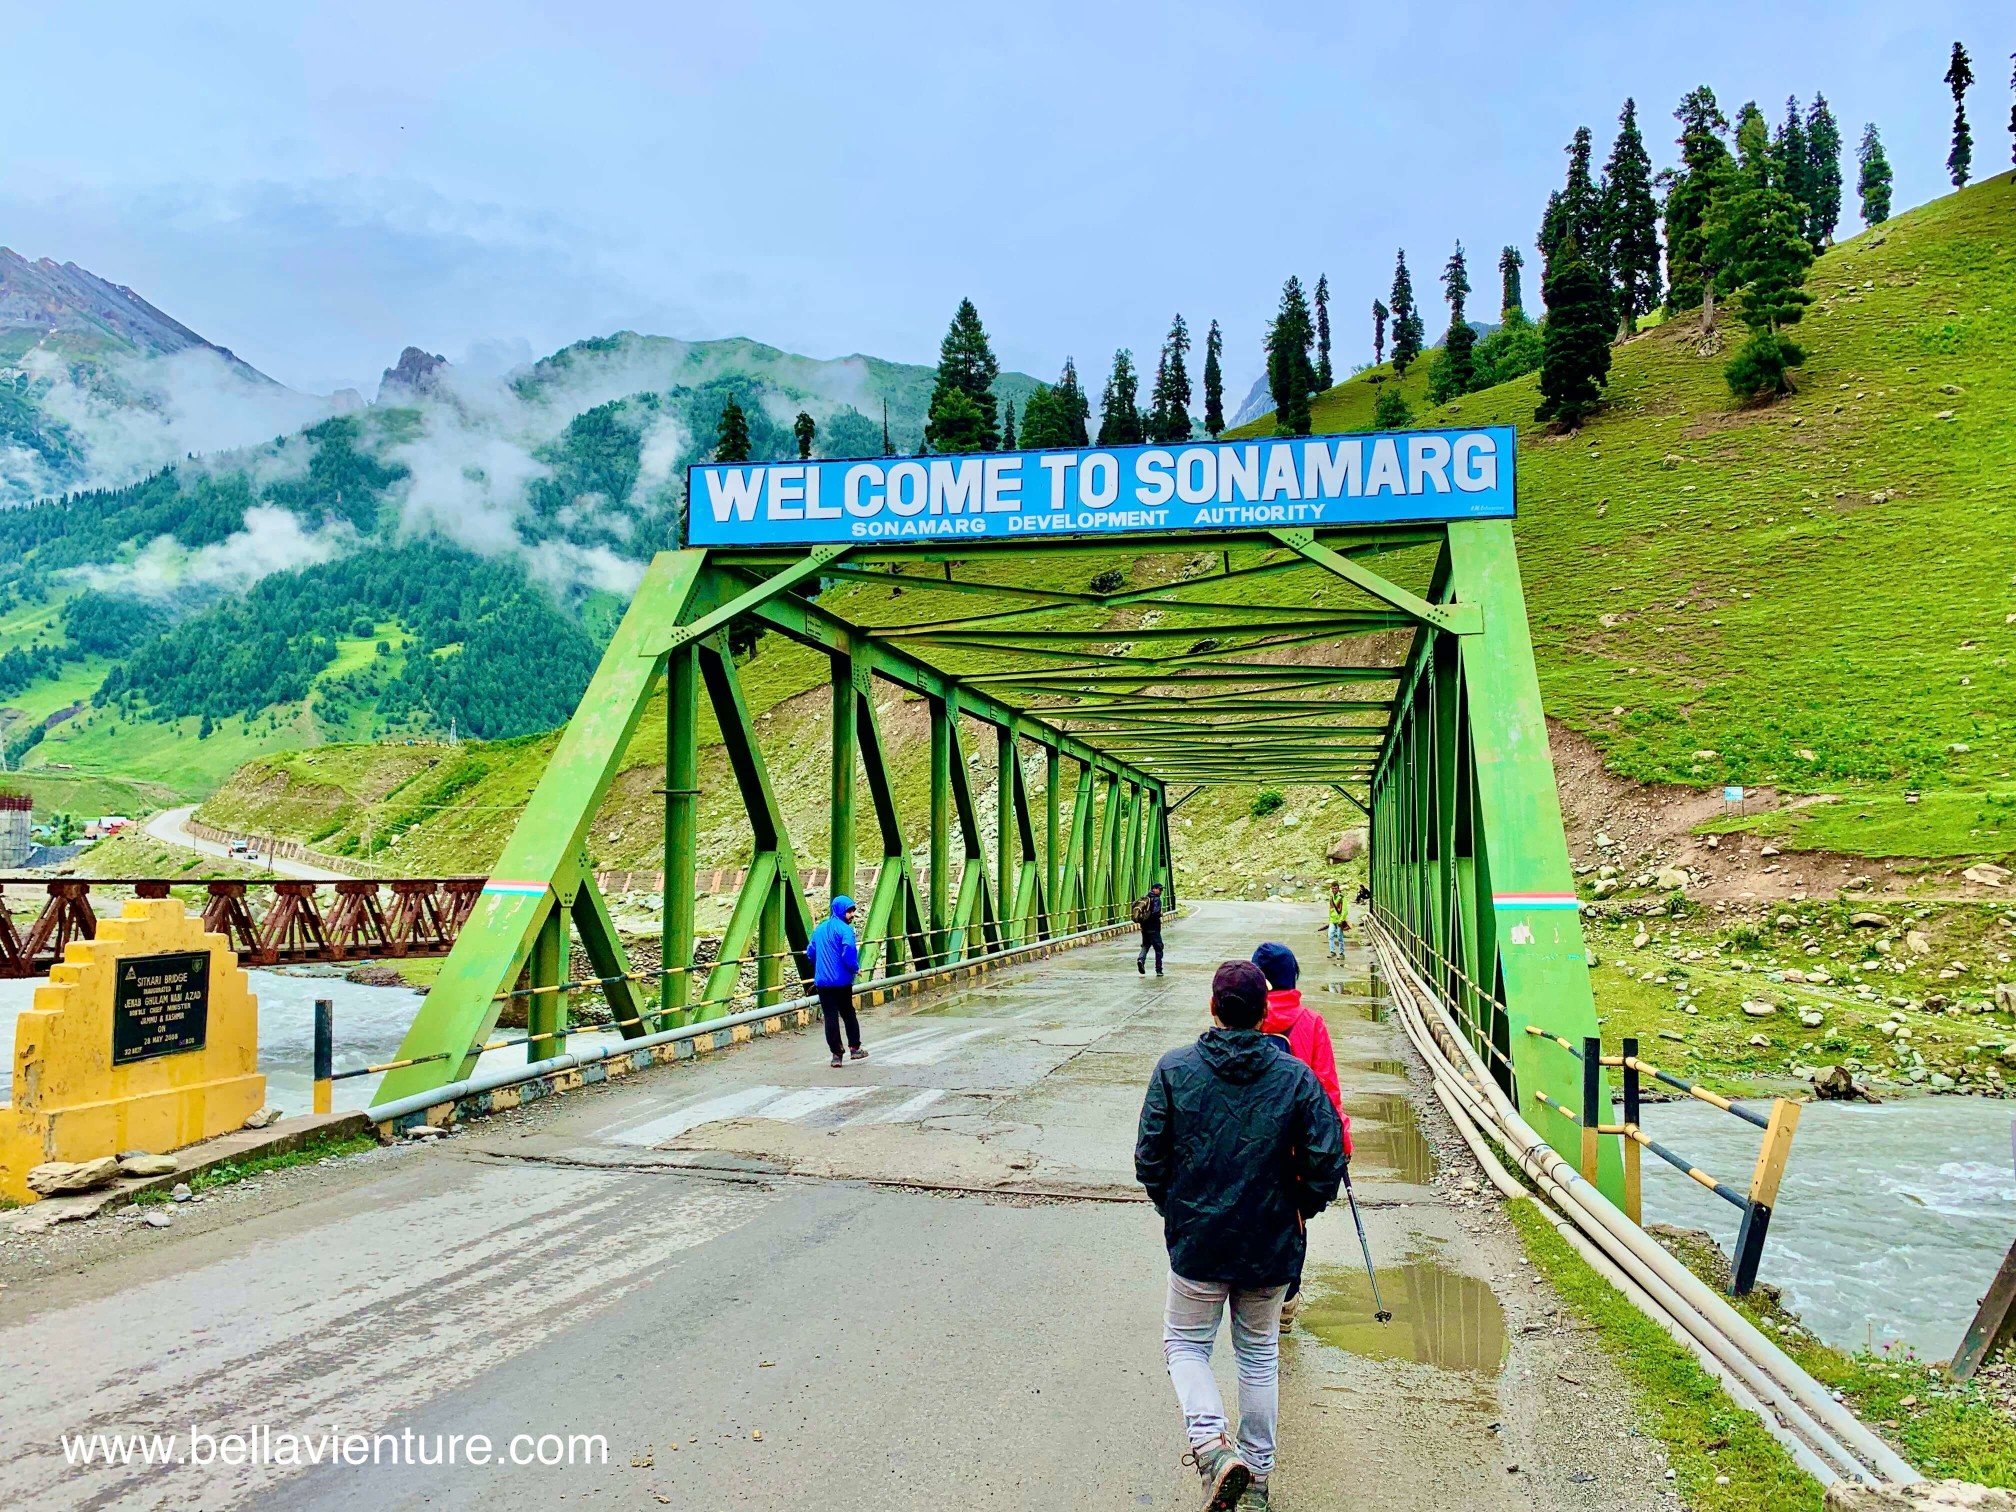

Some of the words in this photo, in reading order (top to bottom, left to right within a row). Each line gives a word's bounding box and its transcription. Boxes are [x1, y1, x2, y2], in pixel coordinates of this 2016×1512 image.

[705, 457, 1023, 523] WELCOME
[1040, 452, 1119, 511] TO
[1135, 433, 1498, 507] SONAMARG
[851, 517, 987, 537] SONAMARG
[1008, 509, 1169, 532] DEVELOPMENT
[1194, 503, 1325, 524] AUTHORITY
[164, 972, 188, 984] BRIDGE
[145, 995, 168, 1006] GHULAM
[185, 991, 201, 1001] AZAD
[140, 1016, 157, 1024] JAMMU
[165, 1012, 184, 1021] KASHMIR
[157, 1025, 166, 1033] ON
[152, 1035, 163, 1044] MAY
